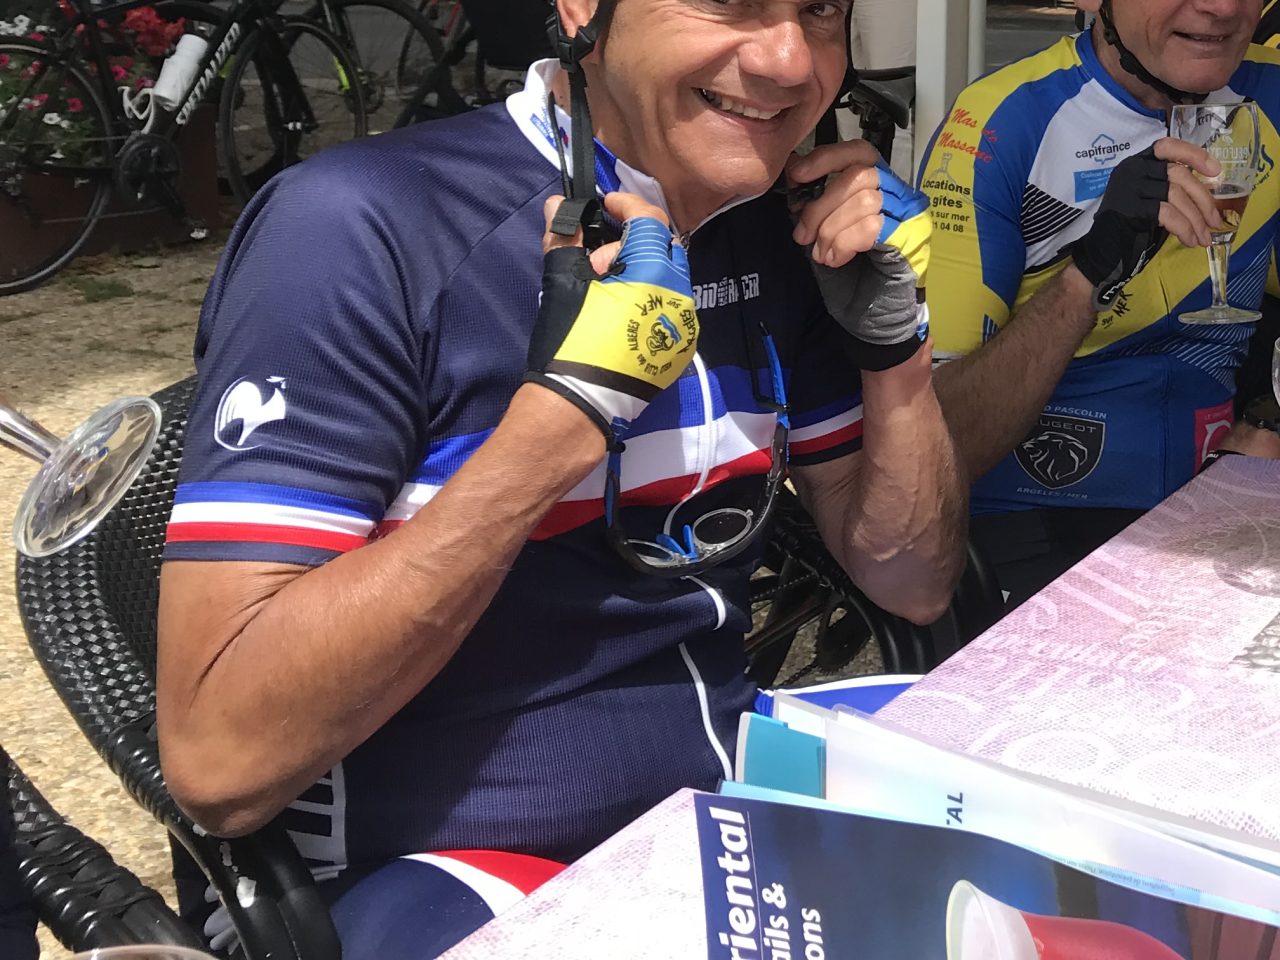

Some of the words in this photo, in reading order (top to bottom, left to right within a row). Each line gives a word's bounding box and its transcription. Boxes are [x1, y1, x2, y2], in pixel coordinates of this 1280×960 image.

[1075, 142, 1131, 158] capifrance
[922, 178, 971, 195] Locations
[635, 293, 663, 316] MER
[1054, 406, 1108, 419] PASCOLIN
[946, 792, 963, 825] AL
[762, 882, 787, 909] &
